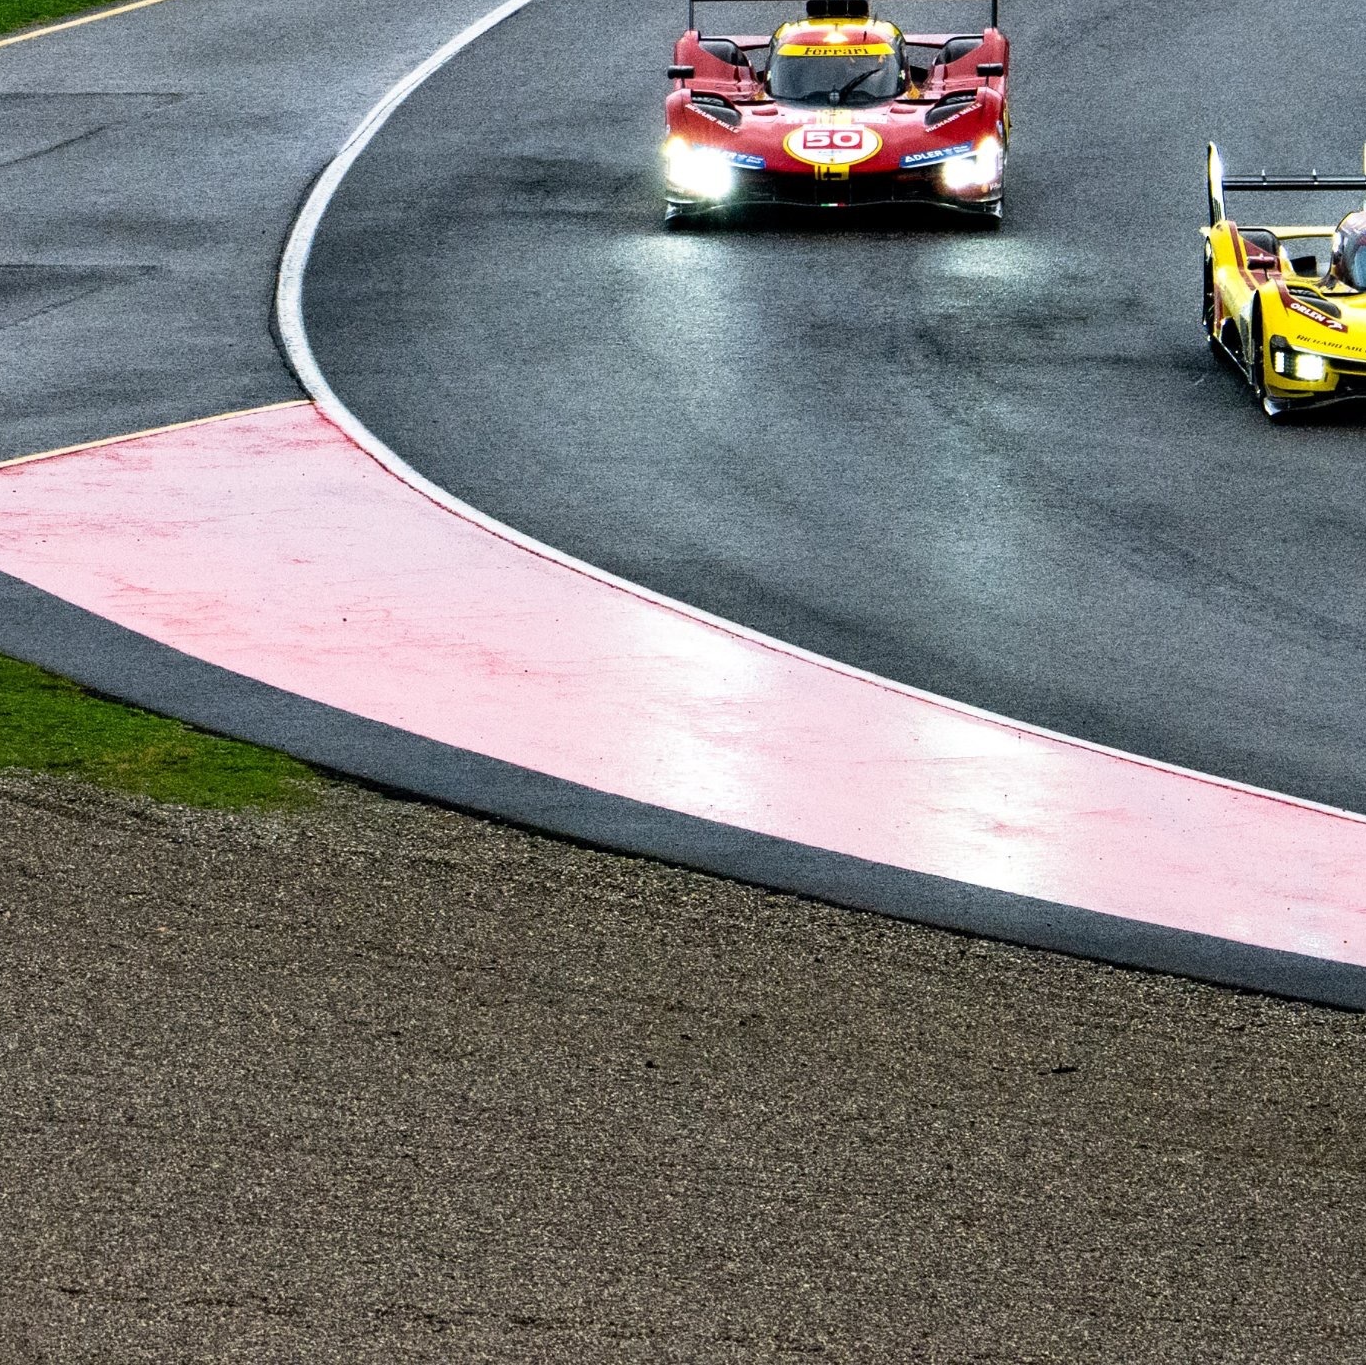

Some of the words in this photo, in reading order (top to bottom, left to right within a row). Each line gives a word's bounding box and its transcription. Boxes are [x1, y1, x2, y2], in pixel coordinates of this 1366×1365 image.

[804, 47, 869, 56] Ferrari
[925, 114, 960, 133] RICHARD
[806, 131, 861, 148] 50
[905, 150, 944, 163] ADLER
[1290, 302, 1327, 322] ORLEN
[1296, 334, 1343, 349] RICHARD
